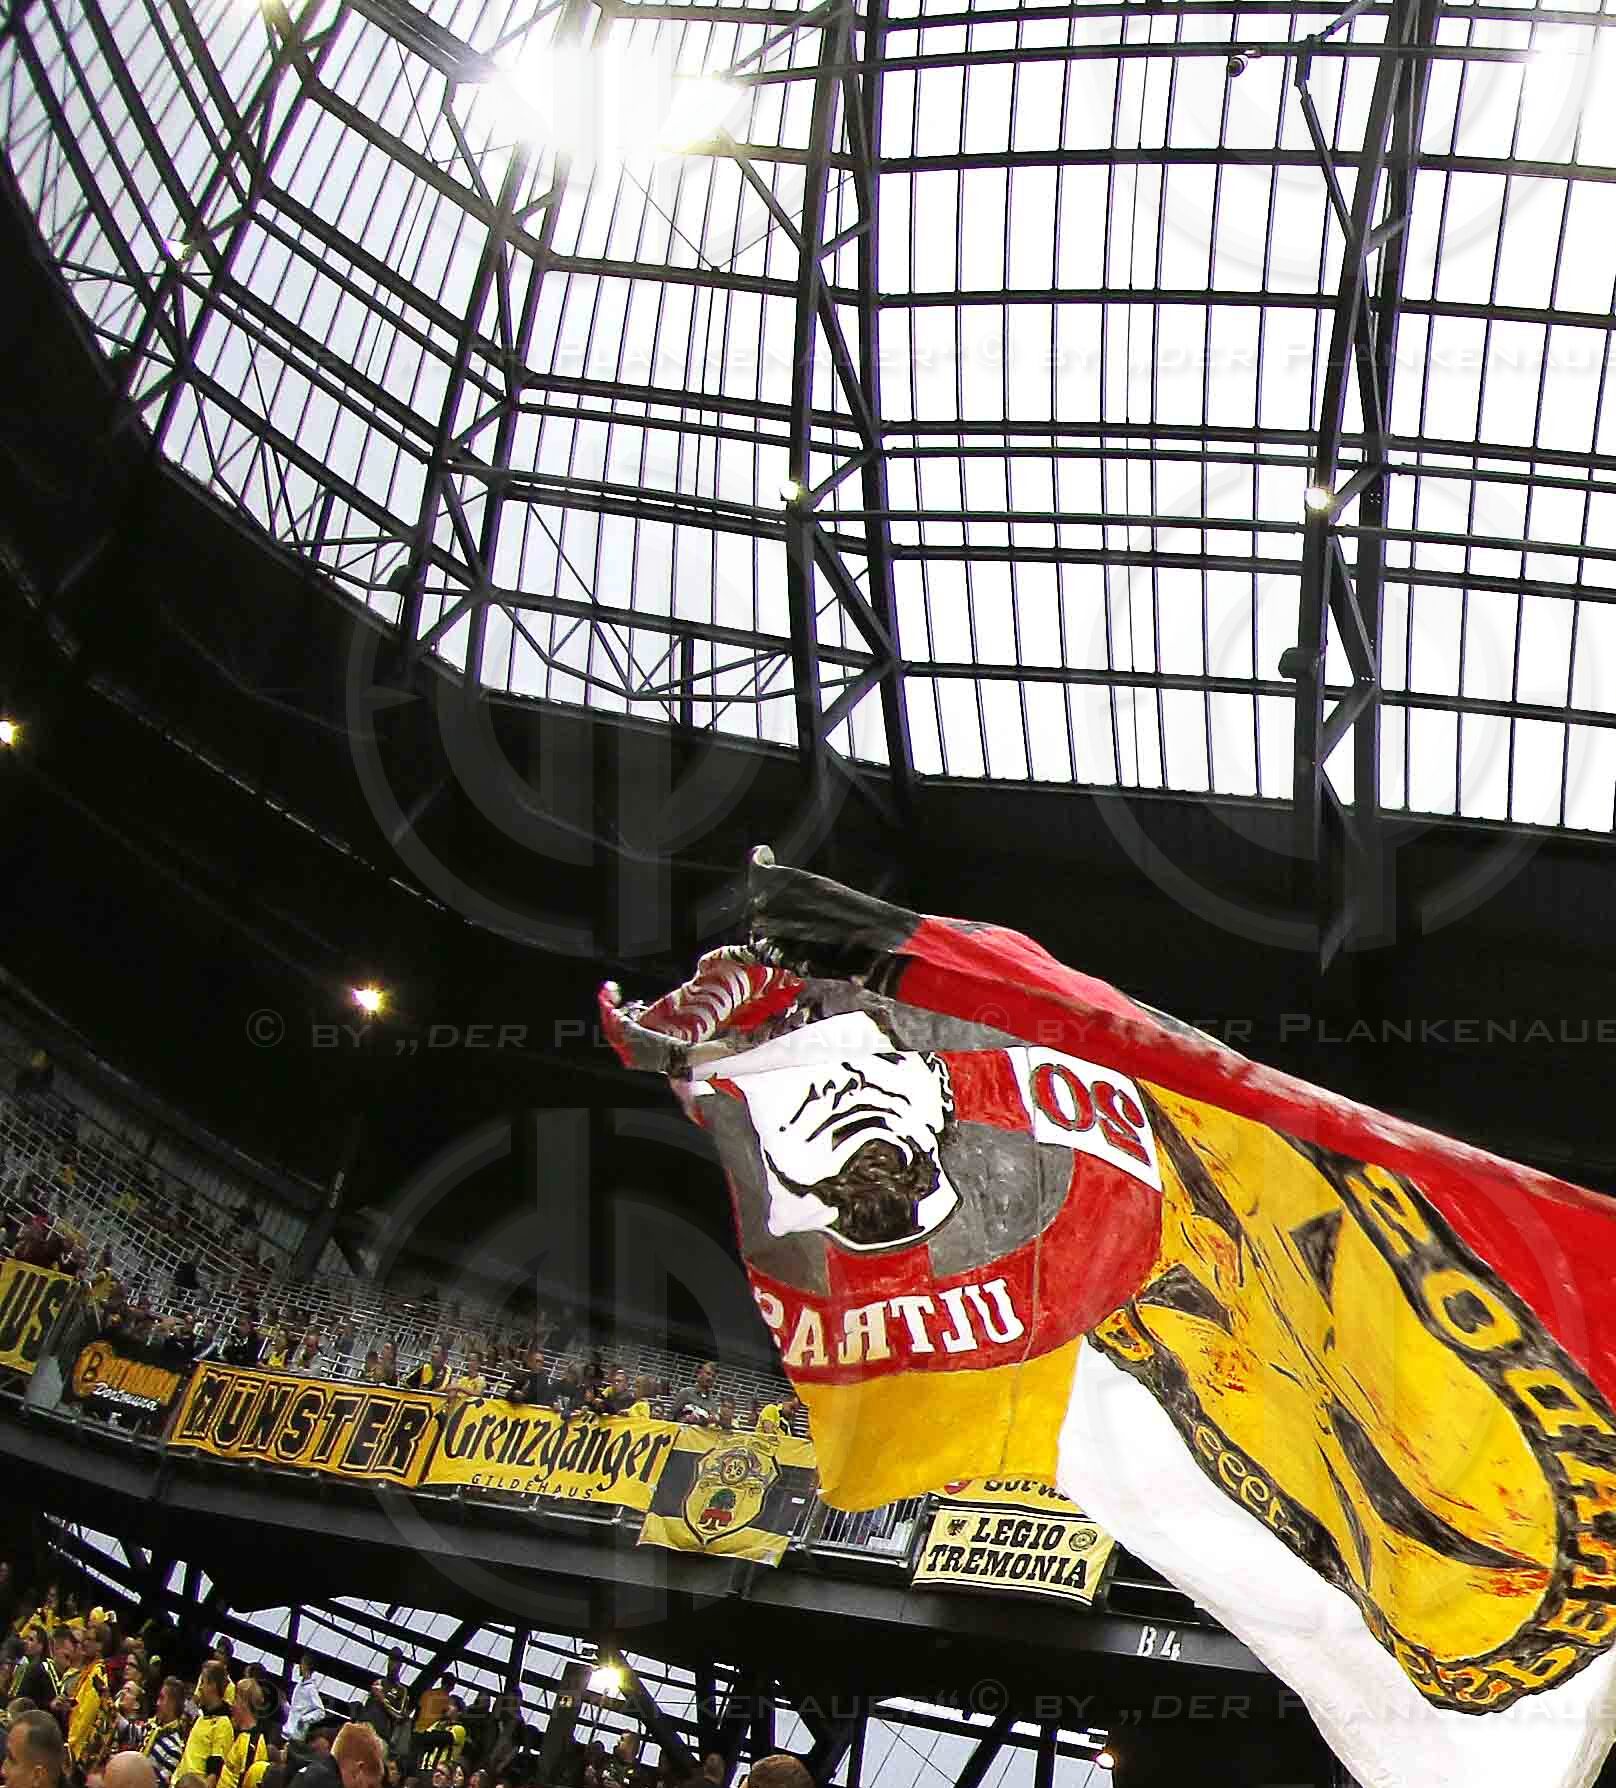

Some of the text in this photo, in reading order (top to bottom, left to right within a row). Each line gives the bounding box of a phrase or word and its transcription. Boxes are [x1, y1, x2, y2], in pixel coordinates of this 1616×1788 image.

[176, 1366, 432, 1476] MÜNSTER
[443, 1397, 674, 1493] Grenzgänger
[471, 1472, 595, 1502] GILDEHAUS
[971, 1517, 1067, 1551] LEGIO
[926, 1543, 1089, 1590] TREMONIA
